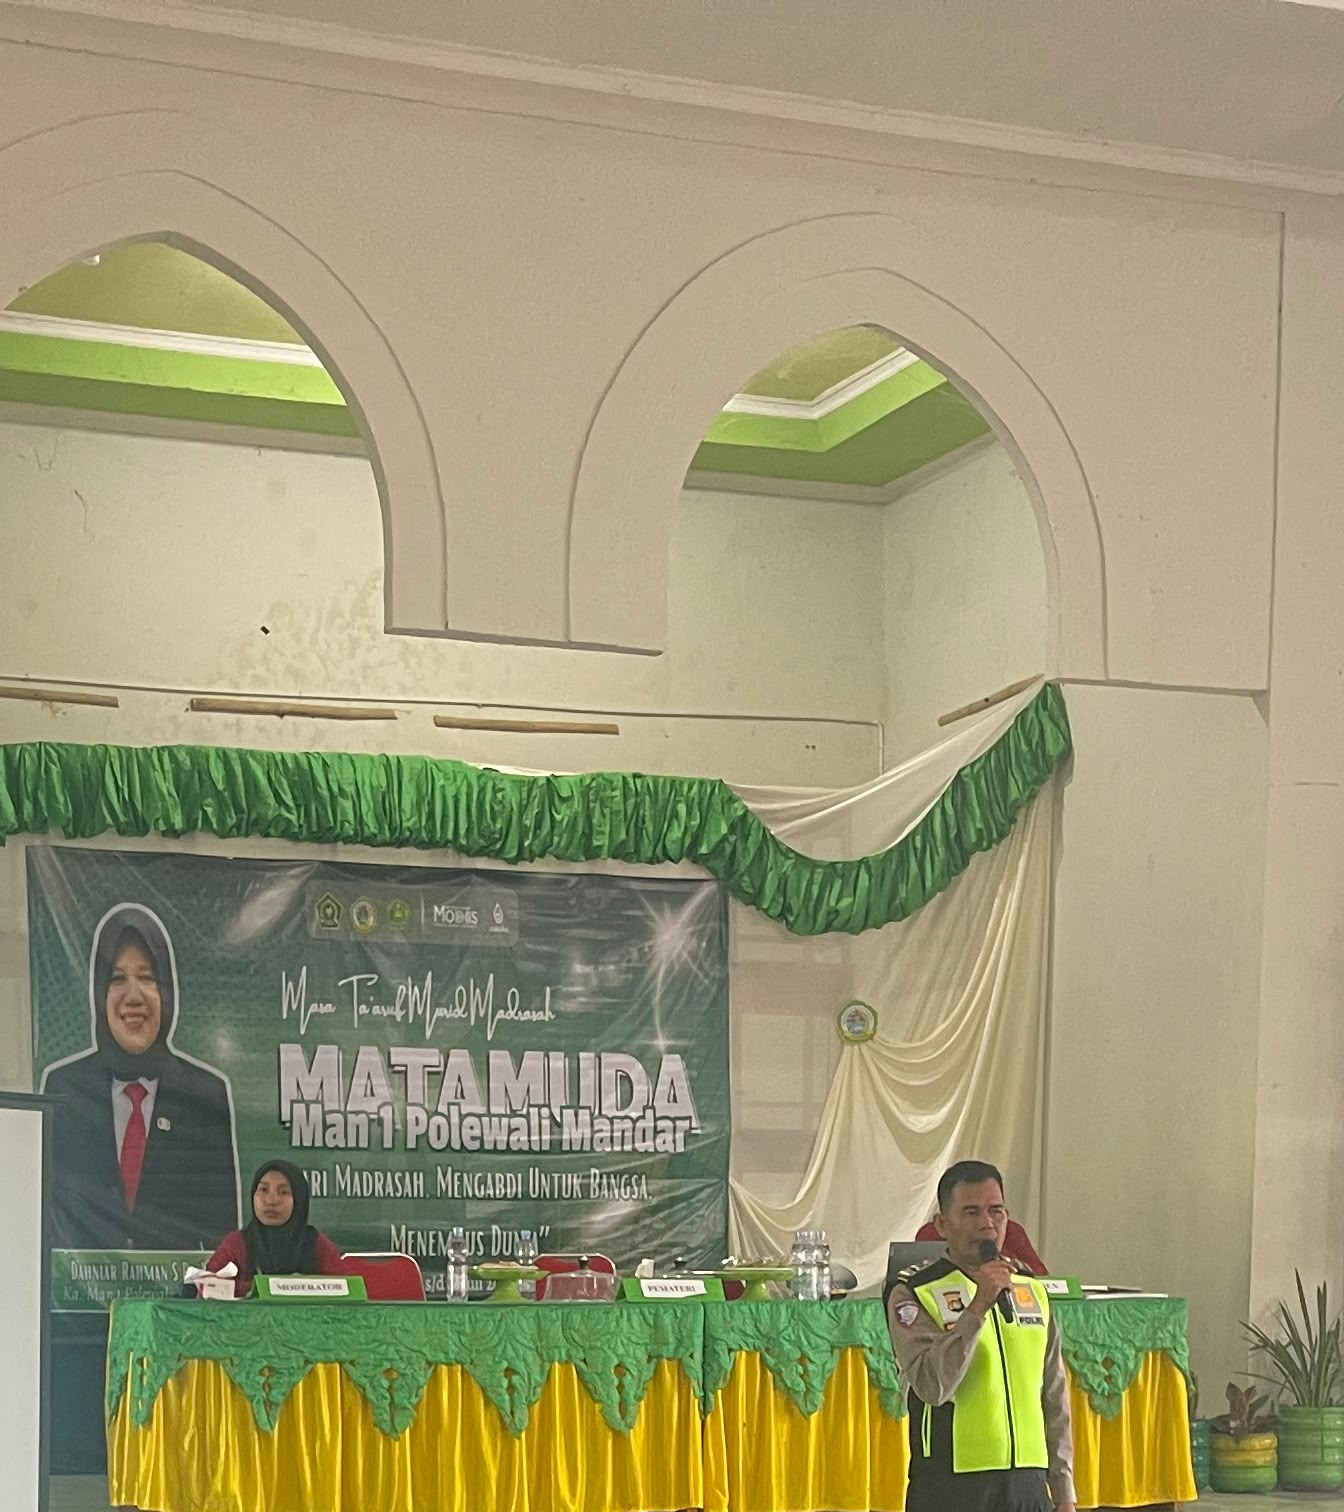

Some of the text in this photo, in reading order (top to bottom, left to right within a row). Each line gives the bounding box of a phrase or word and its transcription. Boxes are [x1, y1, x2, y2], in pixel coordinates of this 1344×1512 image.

[282, 966, 336, 1035] Masa
[408, 971, 468, 1039] Murid
[470, 973, 555, 1040] Madrasah
[279, 1043, 697, 1128] MATAMUDA
[291, 1103, 692, 1152] Man 1 Polewali Mandar
[390, 1224, 485, 1257] MENEMUS
[276, 1284, 343, 1292] MODERATOR
[648, 1285, 696, 1293] PEMATERI
